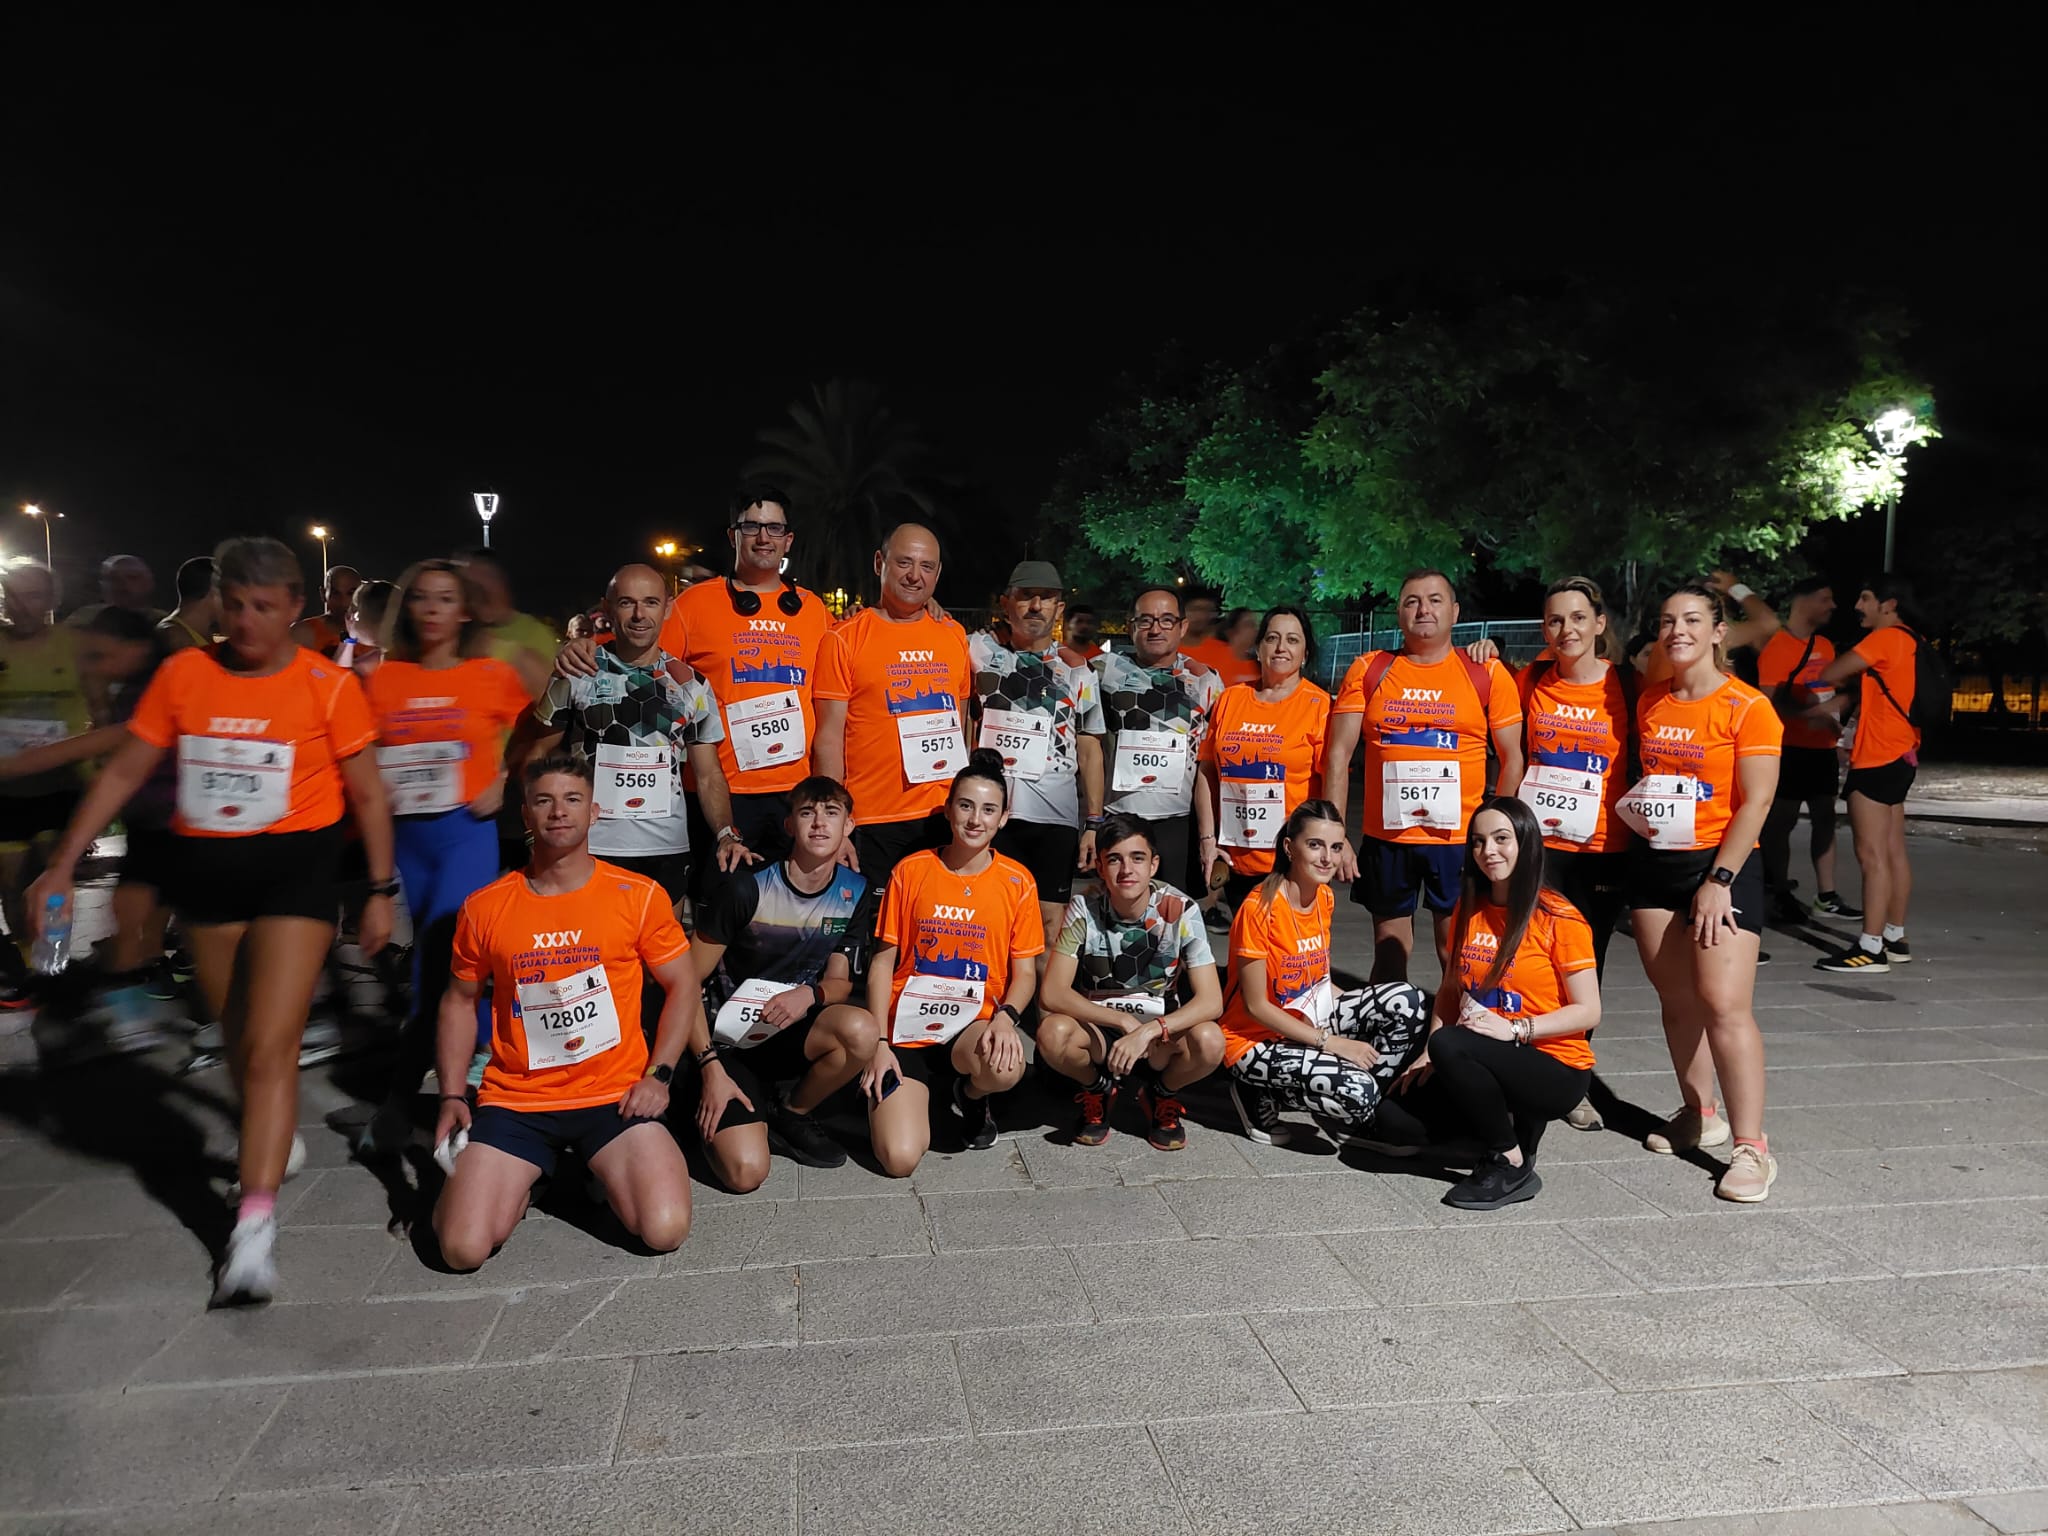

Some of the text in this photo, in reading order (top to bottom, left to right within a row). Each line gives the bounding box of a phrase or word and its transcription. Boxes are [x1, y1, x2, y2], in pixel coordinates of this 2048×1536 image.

[748, 620, 786, 633] XXXV
[739, 637, 801, 648] GUADALQUIVIR
[898, 650, 934, 663] XXXV
[1401, 688, 1443, 701] XXXV
[1387, 706, 1456, 717] GUADALQUIVIR
[1417, 701, 1456, 709] NOCTURNA
[1554, 703, 1597, 721] XXXV
[751, 718, 790, 738] 5580
[1240, 721, 1277, 734] XXXV
[1537, 718, 1608, 735] GUADALQUIVIR
[1656, 725, 1696, 742] XXXV
[921, 736, 955, 753] 5573
[995, 734, 1030, 751] 5557
[1132, 753, 1169, 768] 5605
[615, 772, 656, 788] 5569
[1400, 786, 1440, 801] 5617
[1535, 791, 1578, 811] 5623
[1235, 805, 1267, 821] 5592
[933, 904, 975, 921] XXXV
[920, 926, 986, 940] GUADALQUIVIR
[949, 920, 987, 931] NOCTURNA
[532, 929, 582, 949] XXXV
[1471, 932, 1498, 949] XXX
[513, 945, 599, 961] CARRERA NOCTURNA
[520, 954, 600, 969] GUADALQUIVIR
[540, 1001, 598, 1030] 12802
[740, 1006, 762, 1023] 55
[919, 1002, 960, 1017] 5609
[1106, 1002, 1145, 1015] 5586
